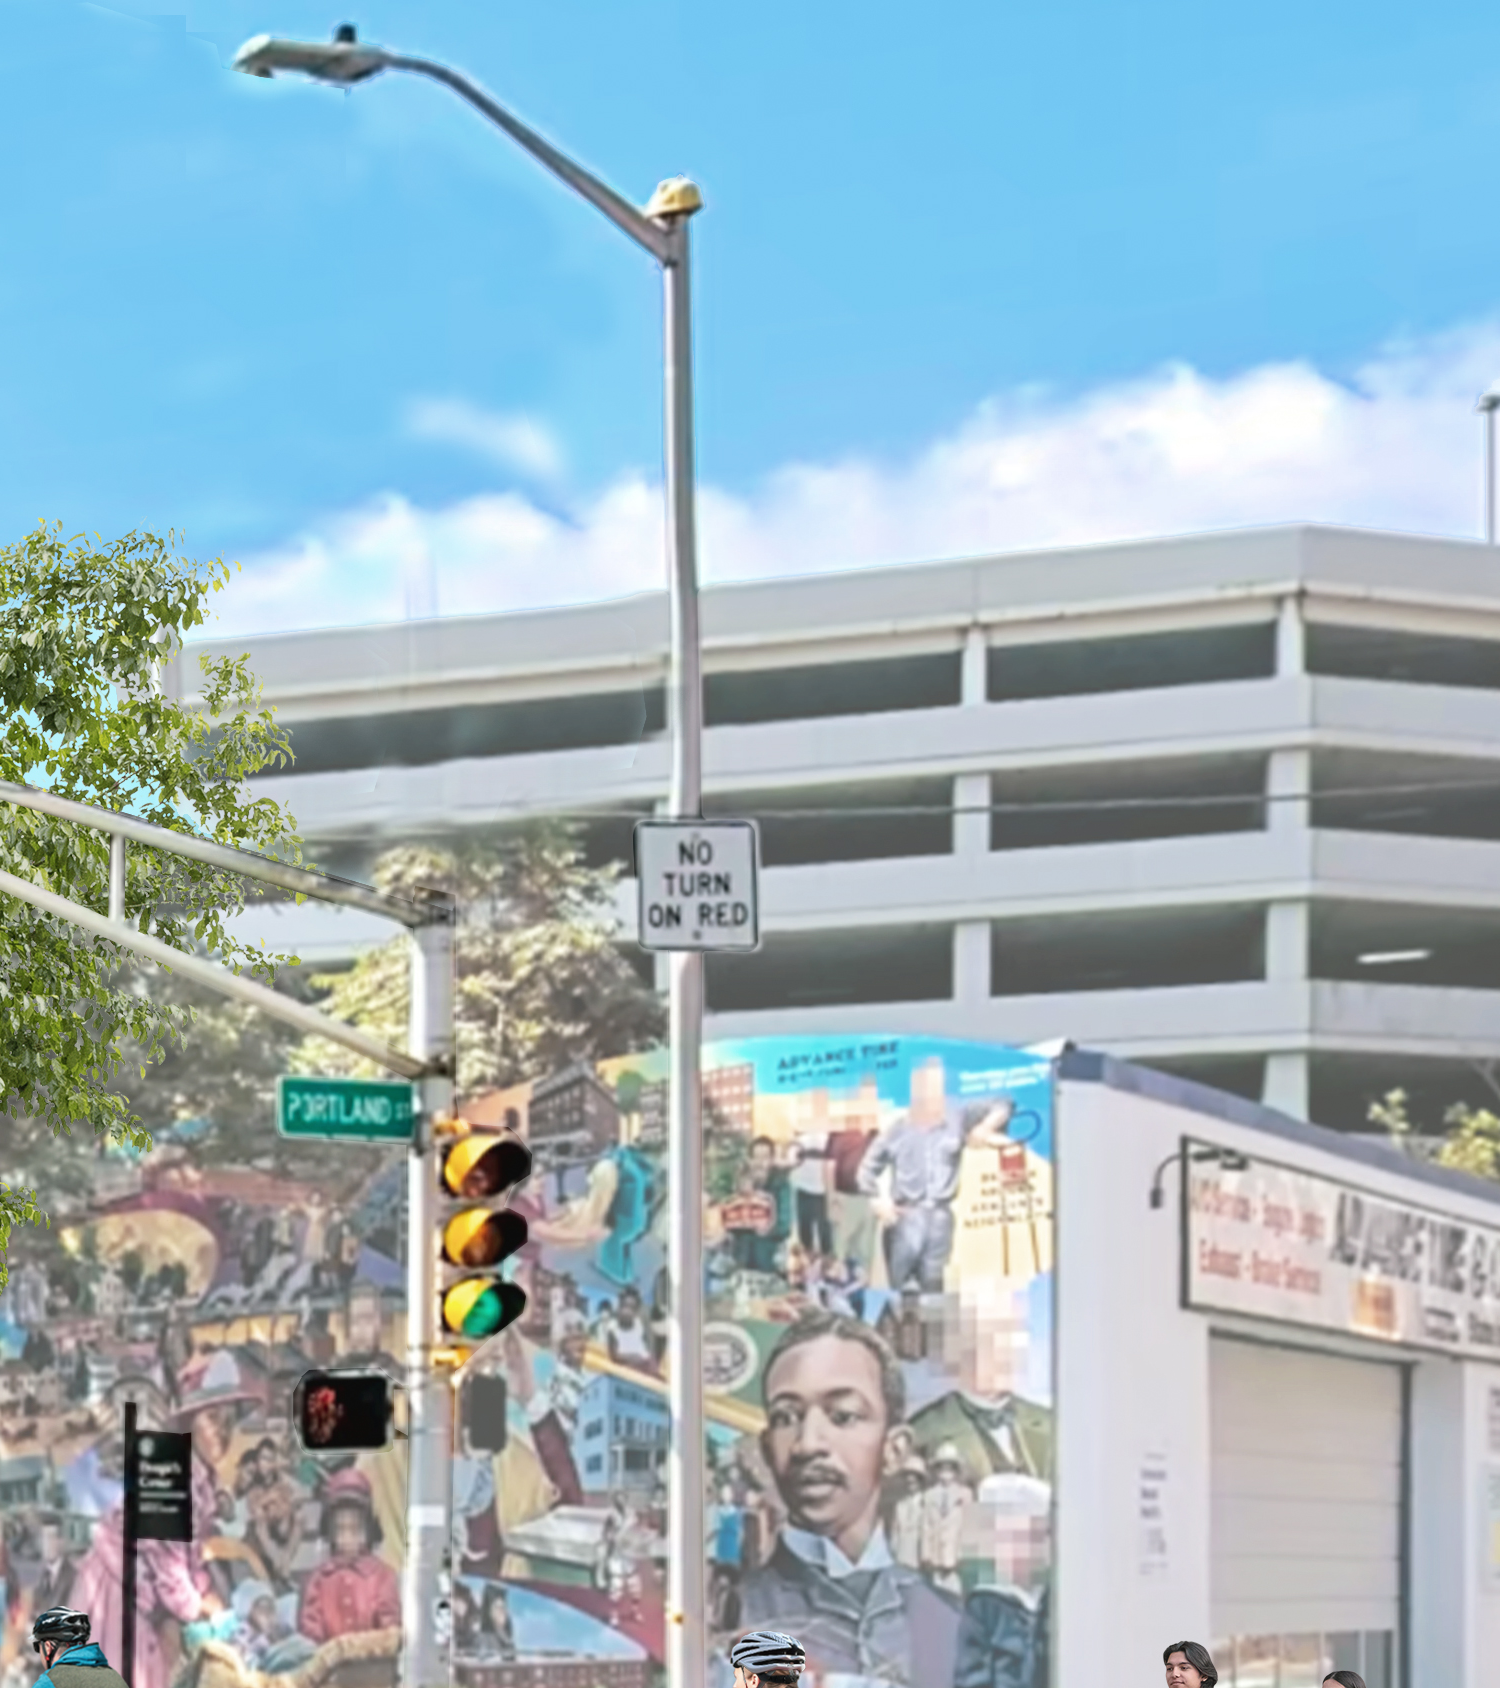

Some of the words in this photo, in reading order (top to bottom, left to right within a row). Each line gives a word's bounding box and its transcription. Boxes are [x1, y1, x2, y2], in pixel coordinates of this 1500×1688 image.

[678, 840, 713, 866] NO
[664, 872, 731, 897] TURN
[649, 903, 682, 928] ON
[698, 902, 748, 926] RED
[287, 1091, 392, 1126] PORTLAND
